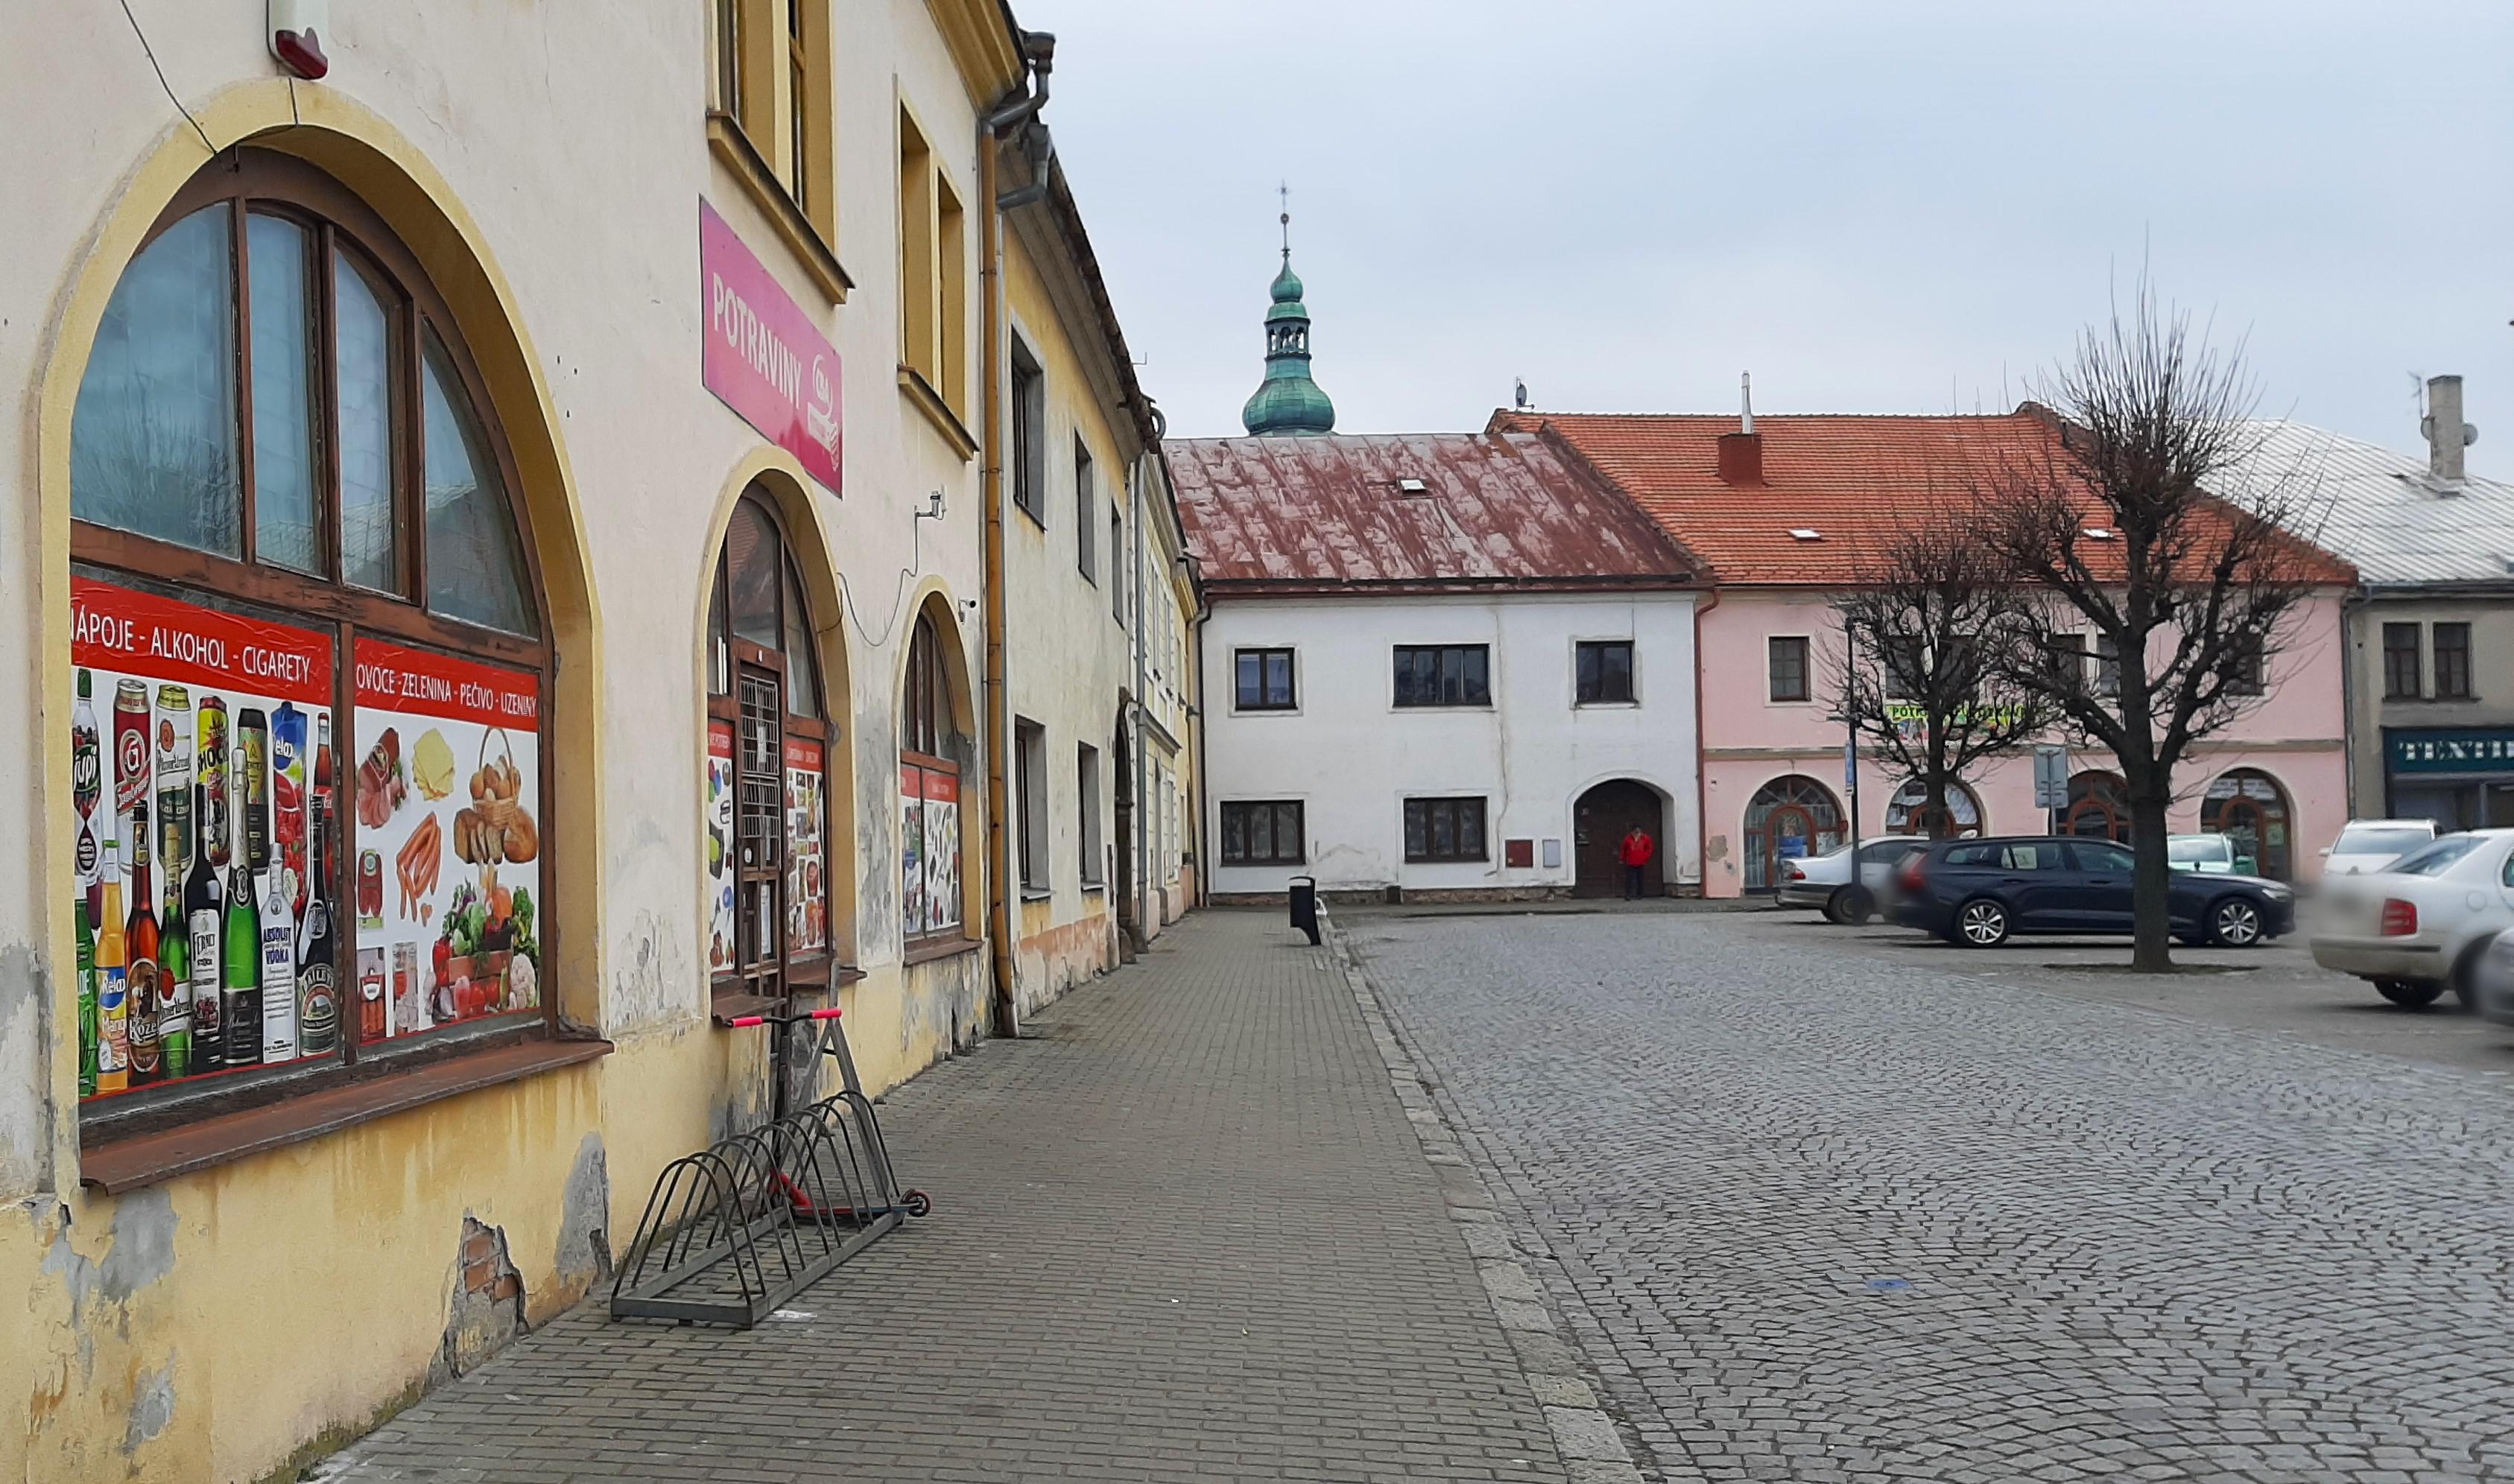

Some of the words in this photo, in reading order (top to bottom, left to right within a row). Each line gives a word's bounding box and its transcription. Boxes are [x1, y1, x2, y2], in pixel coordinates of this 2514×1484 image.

[713, 273, 802, 409] POTRAVINY
[151, 627, 229, 669] ALKOHOL
[243, 646, 310, 685] CIGARETY
[356, 664, 395, 694] OVOCE
[401, 673, 452, 702] ZELENINA
[460, 682, 494, 711] PEČIVO
[266, 948, 289, 965] VODKA
[102, 975, 126, 994] Relax
[101, 1015, 125, 1035] Mang
[128, 1015, 156, 1041] Koze
